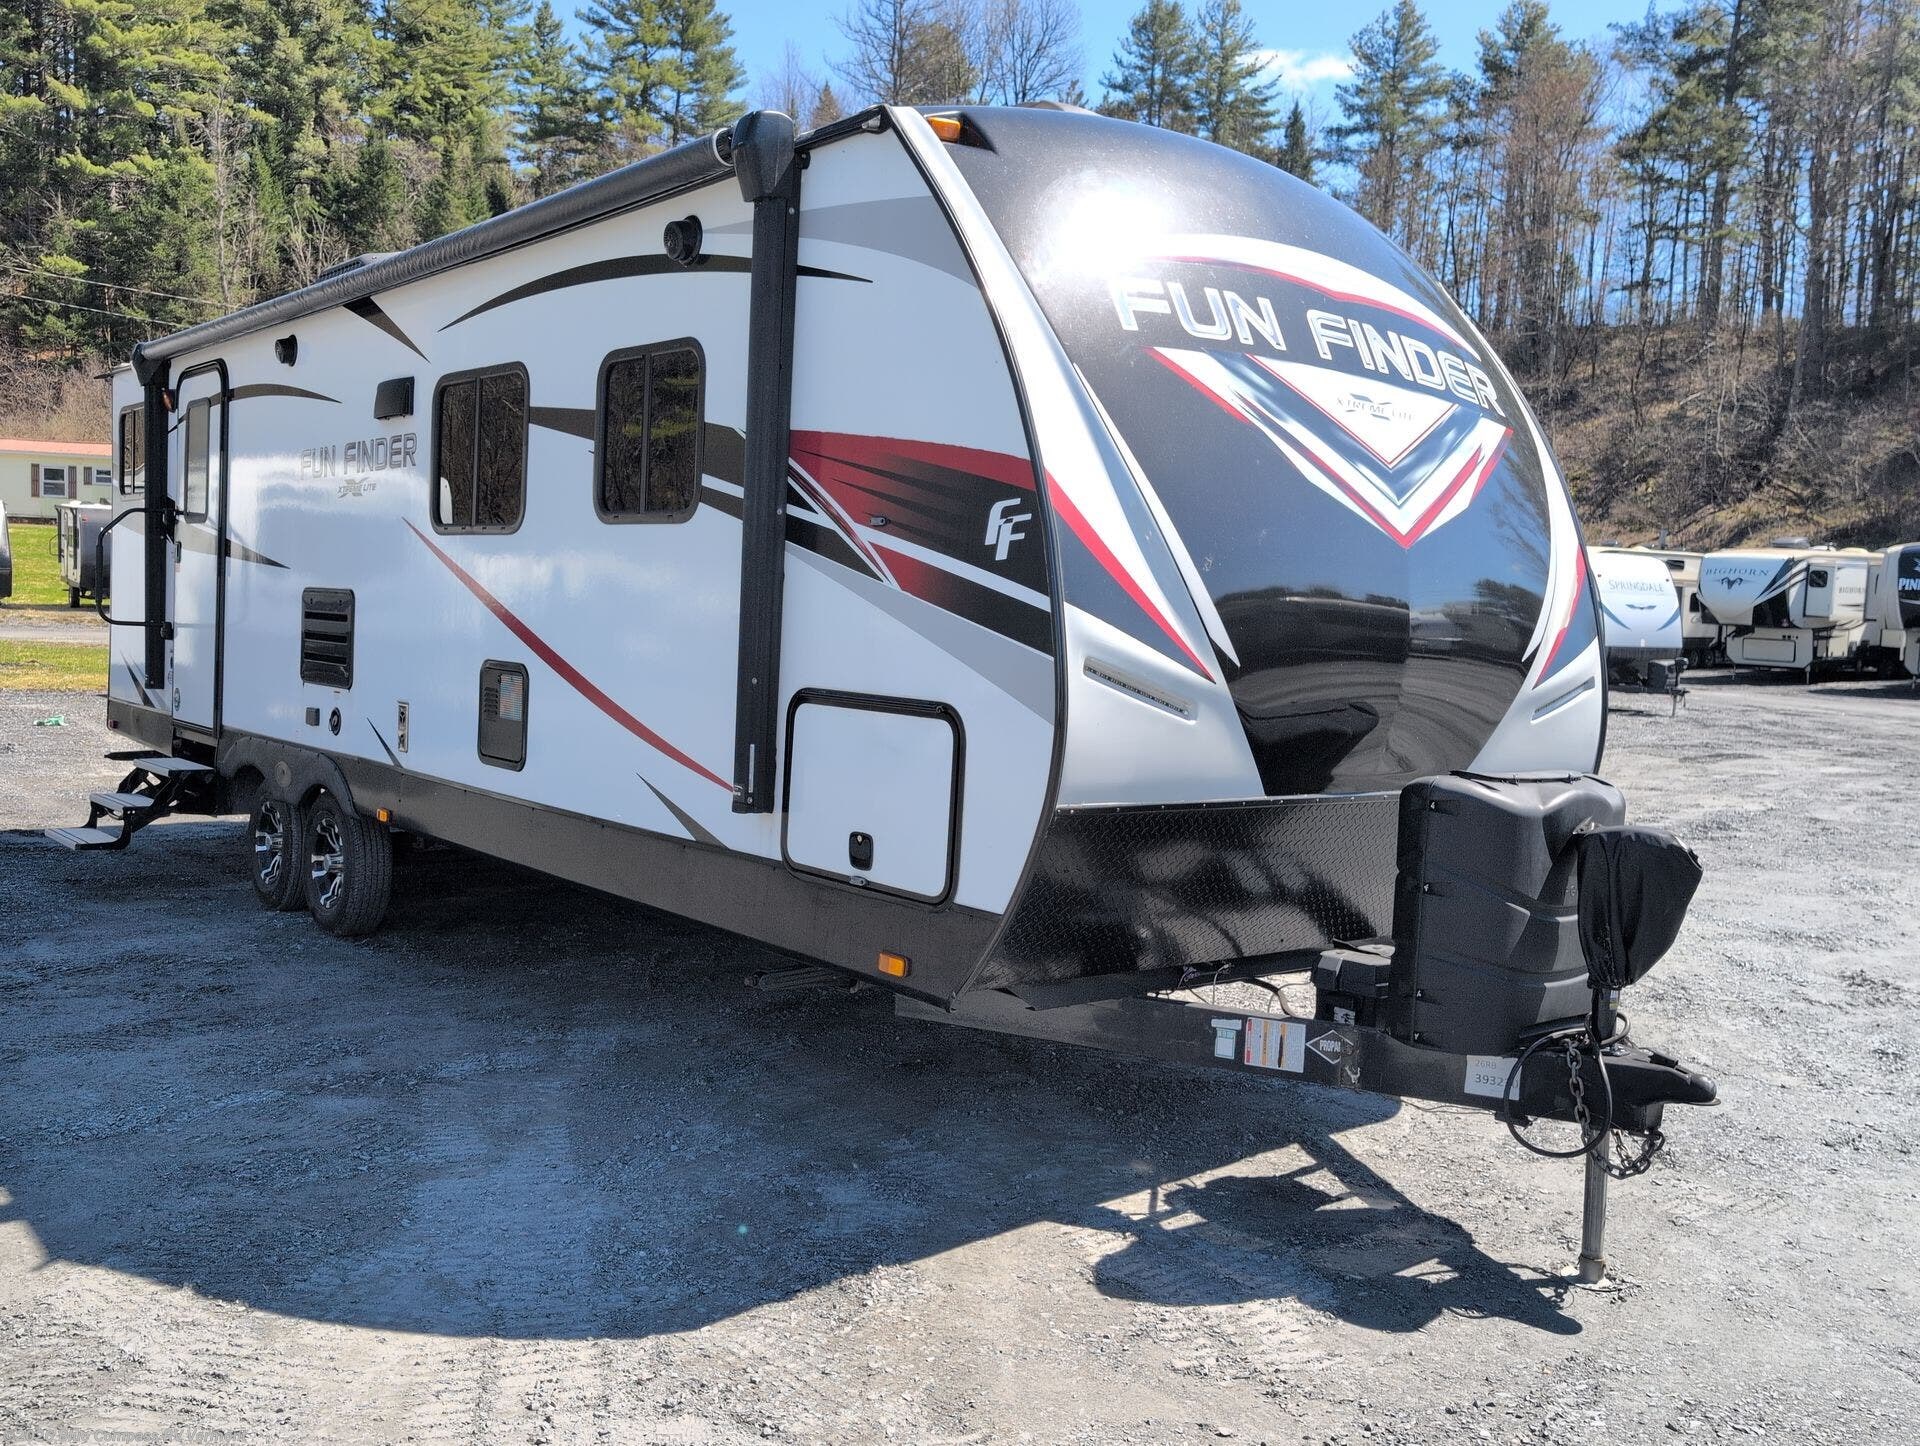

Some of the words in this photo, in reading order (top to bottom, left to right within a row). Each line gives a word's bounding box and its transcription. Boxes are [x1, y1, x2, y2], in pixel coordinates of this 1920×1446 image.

[1109, 277, 1286, 352] FUN
[1305, 308, 1507, 418] FINDER
[300, 445, 336, 480] FUN
[343, 432, 418, 475] FINDER
[1705, 567, 1769, 576] BIGHORN
[1608, 579, 1664, 593] SPRINGDALE
[1474, 1059, 1497, 1070] 26RB
